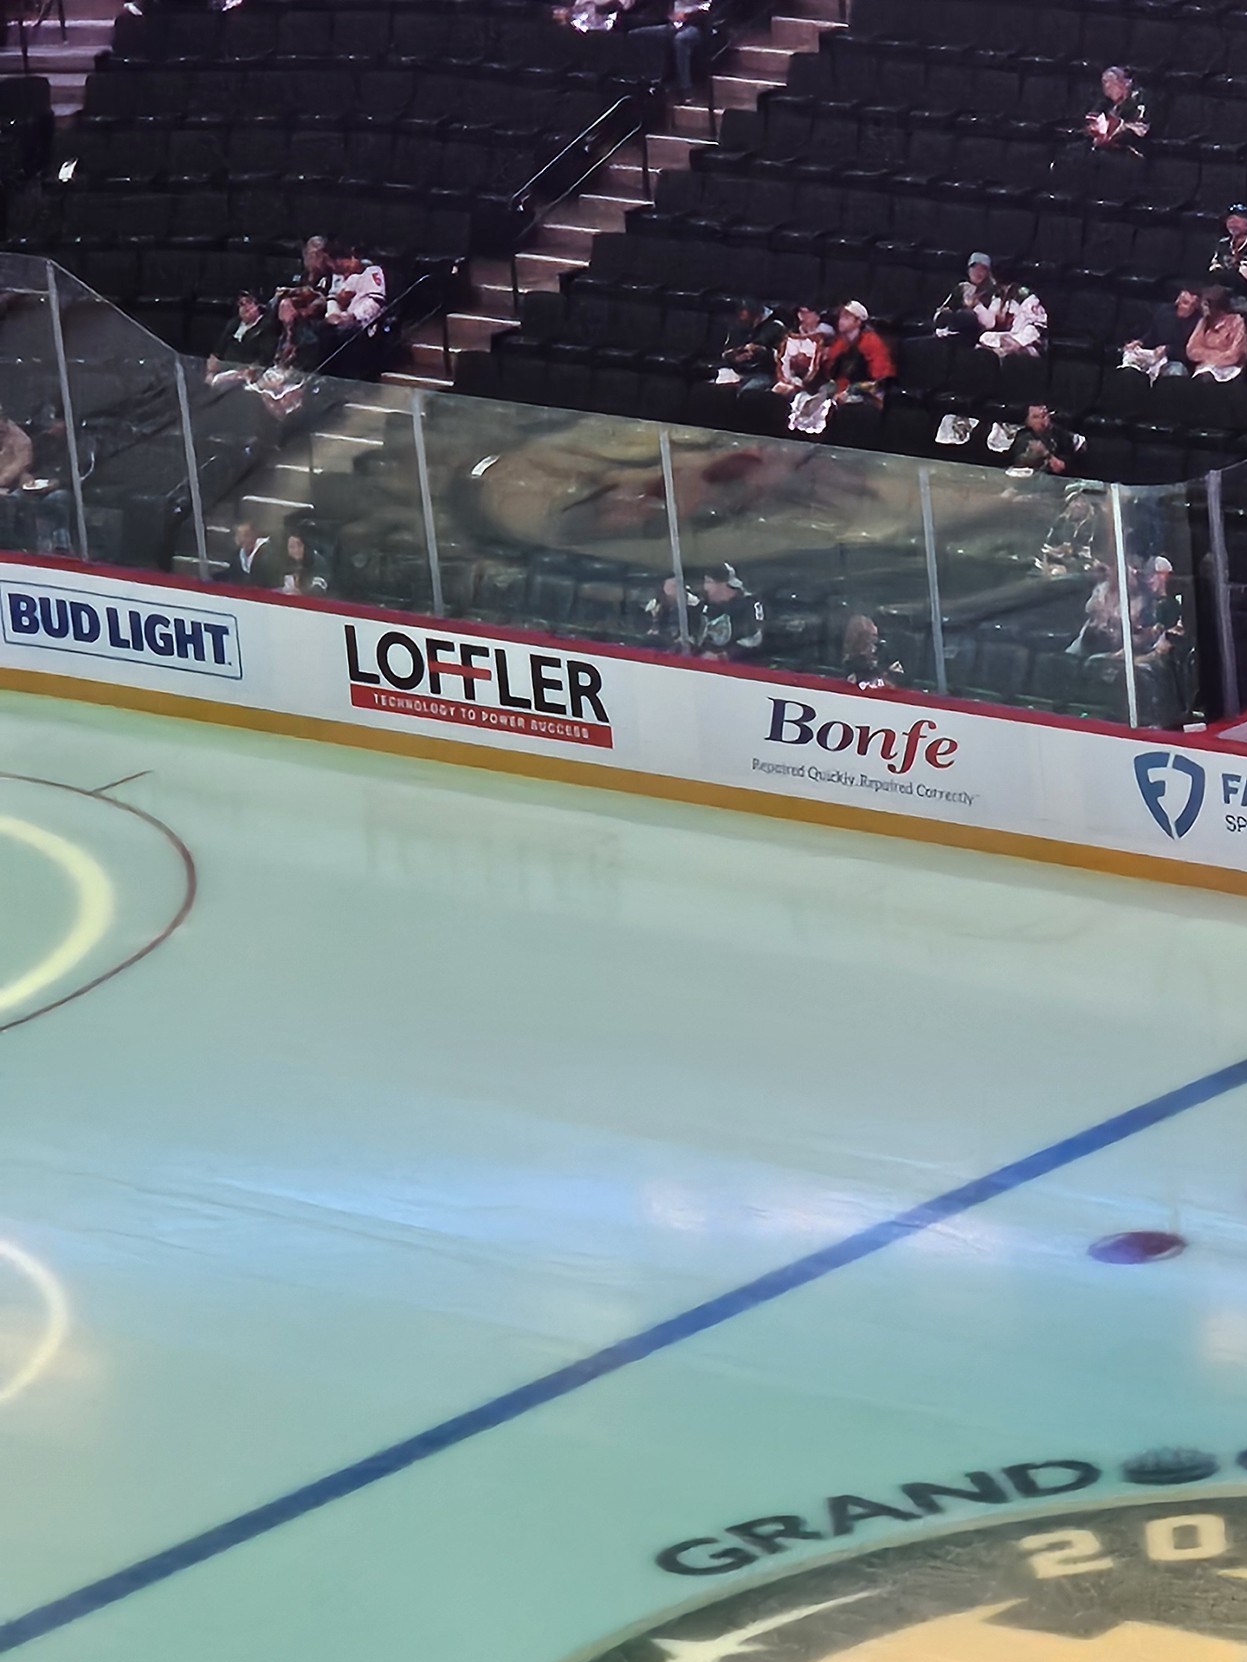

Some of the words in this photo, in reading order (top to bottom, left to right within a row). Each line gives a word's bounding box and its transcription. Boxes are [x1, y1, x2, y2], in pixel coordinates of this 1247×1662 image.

[7, 593, 101, 643] BUD
[106, 607, 231, 666] LIGHT
[345, 624, 609, 723] LOFFLER
[374, 693, 455, 717] TECHNOLOGY
[460, 708, 476, 721] TO
[482, 711, 526, 729] POWER
[764, 696, 959, 775] Bonfe
[655, 1458, 1102, 1577] GRAND
